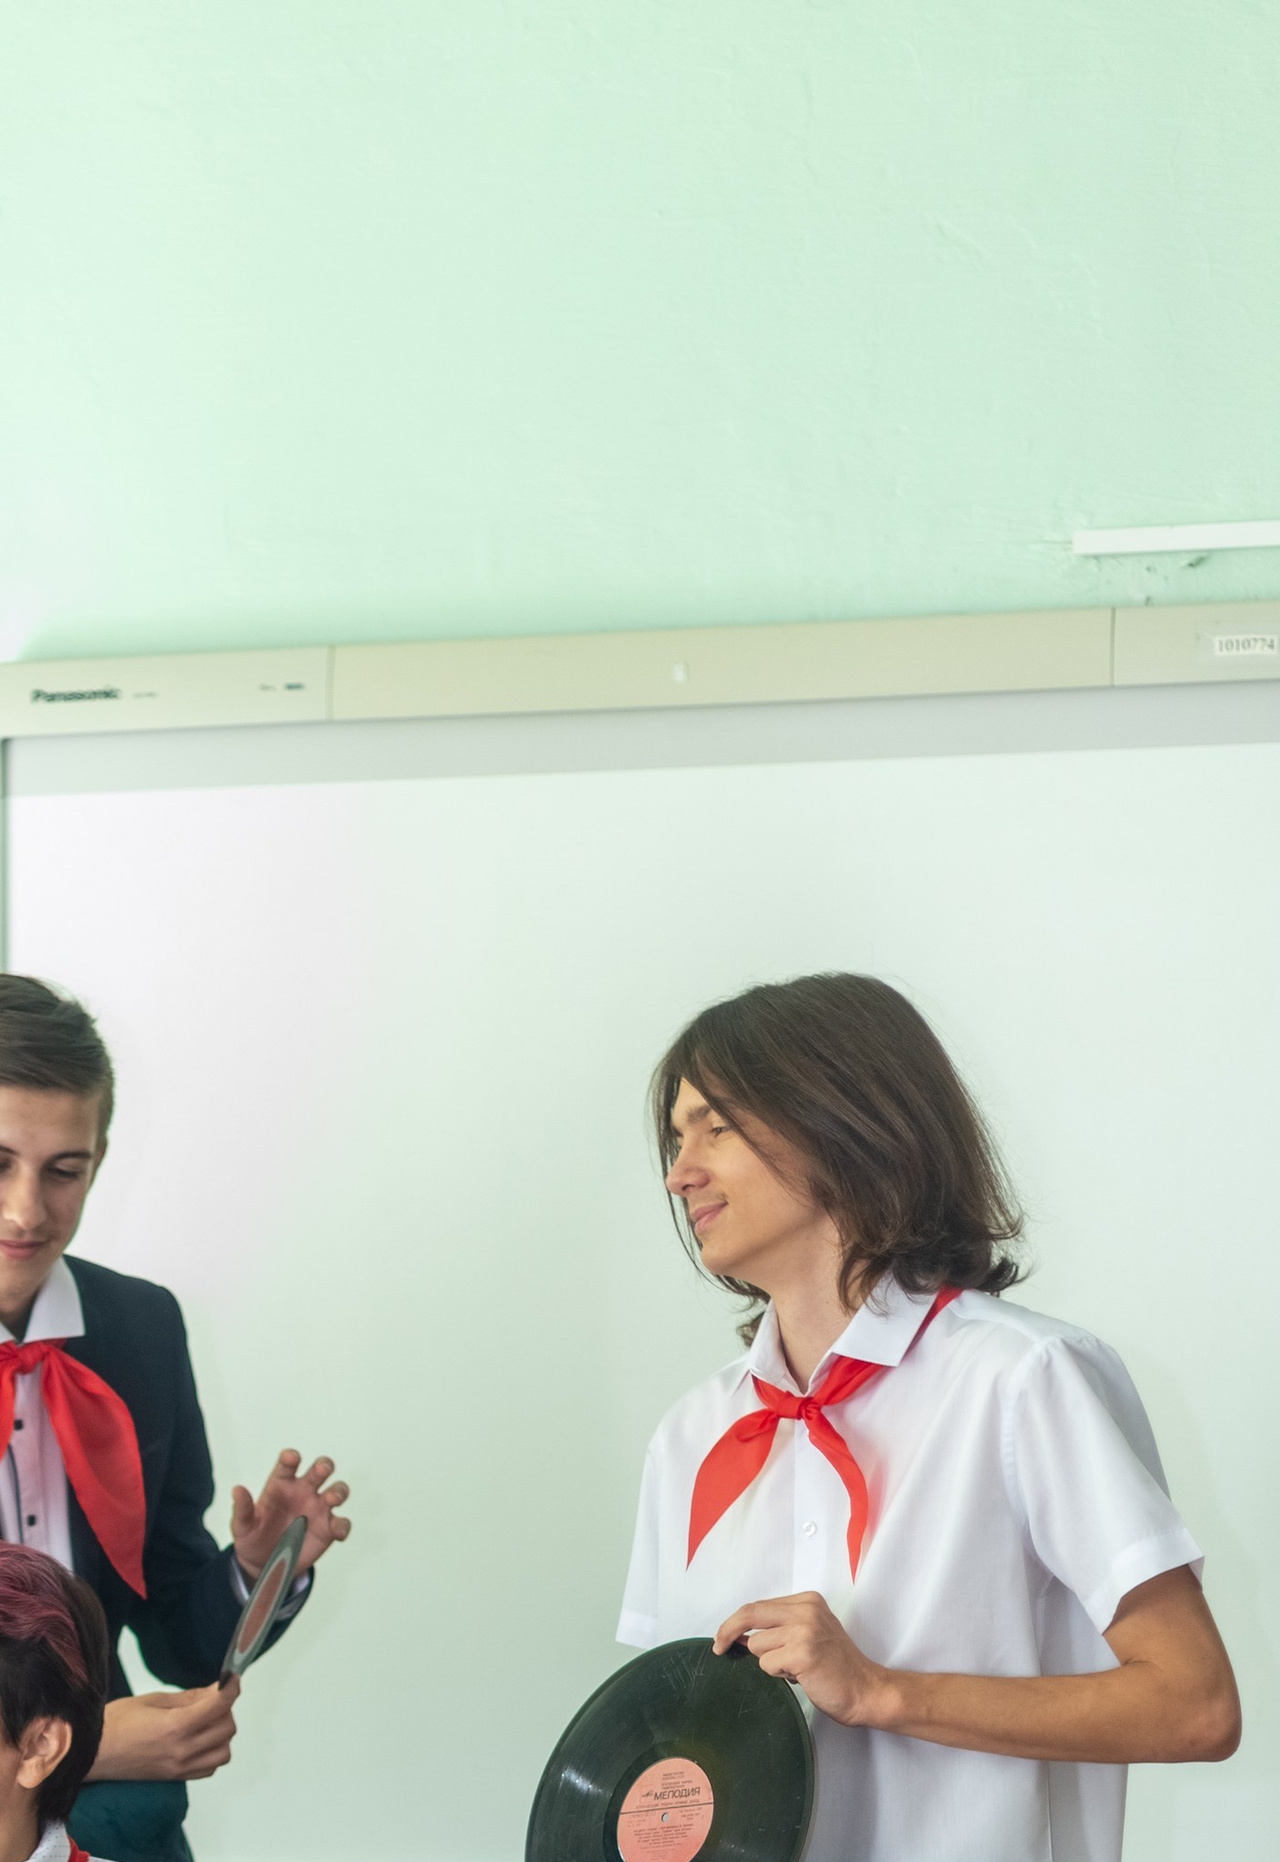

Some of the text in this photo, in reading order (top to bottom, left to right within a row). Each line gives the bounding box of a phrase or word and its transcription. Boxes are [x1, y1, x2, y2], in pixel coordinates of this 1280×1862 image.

[1218, 638, 1275, 651] 1010774
[31, 687, 119, 703] Panasonic
[654, 1787, 701, 1800] МЕЛОДИЯ
